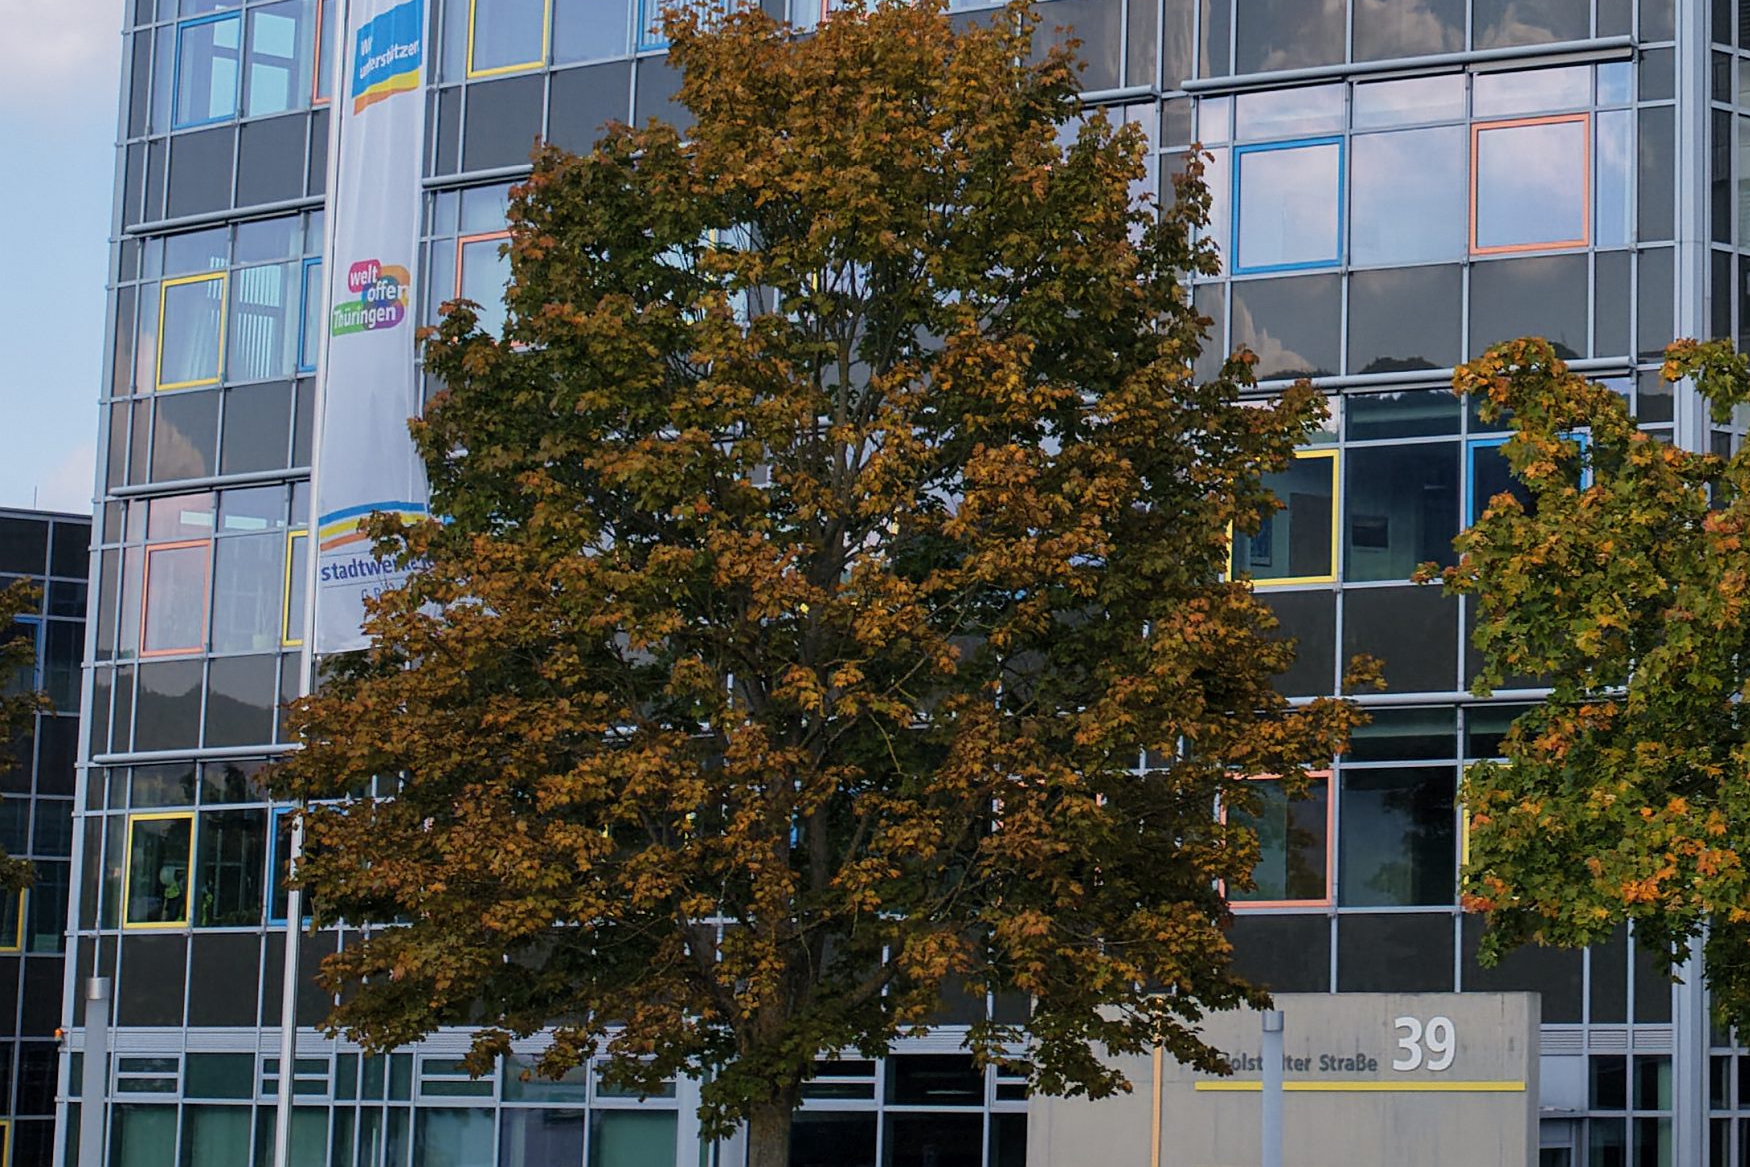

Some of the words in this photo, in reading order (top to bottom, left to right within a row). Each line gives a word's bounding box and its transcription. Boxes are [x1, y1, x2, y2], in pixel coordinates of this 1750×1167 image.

[350, 264, 378, 287] welt
[334, 306, 397, 329] Thüringen
[1319, 1053, 1378, 1072] Straße
[1392, 1015, 1456, 1073] 39
